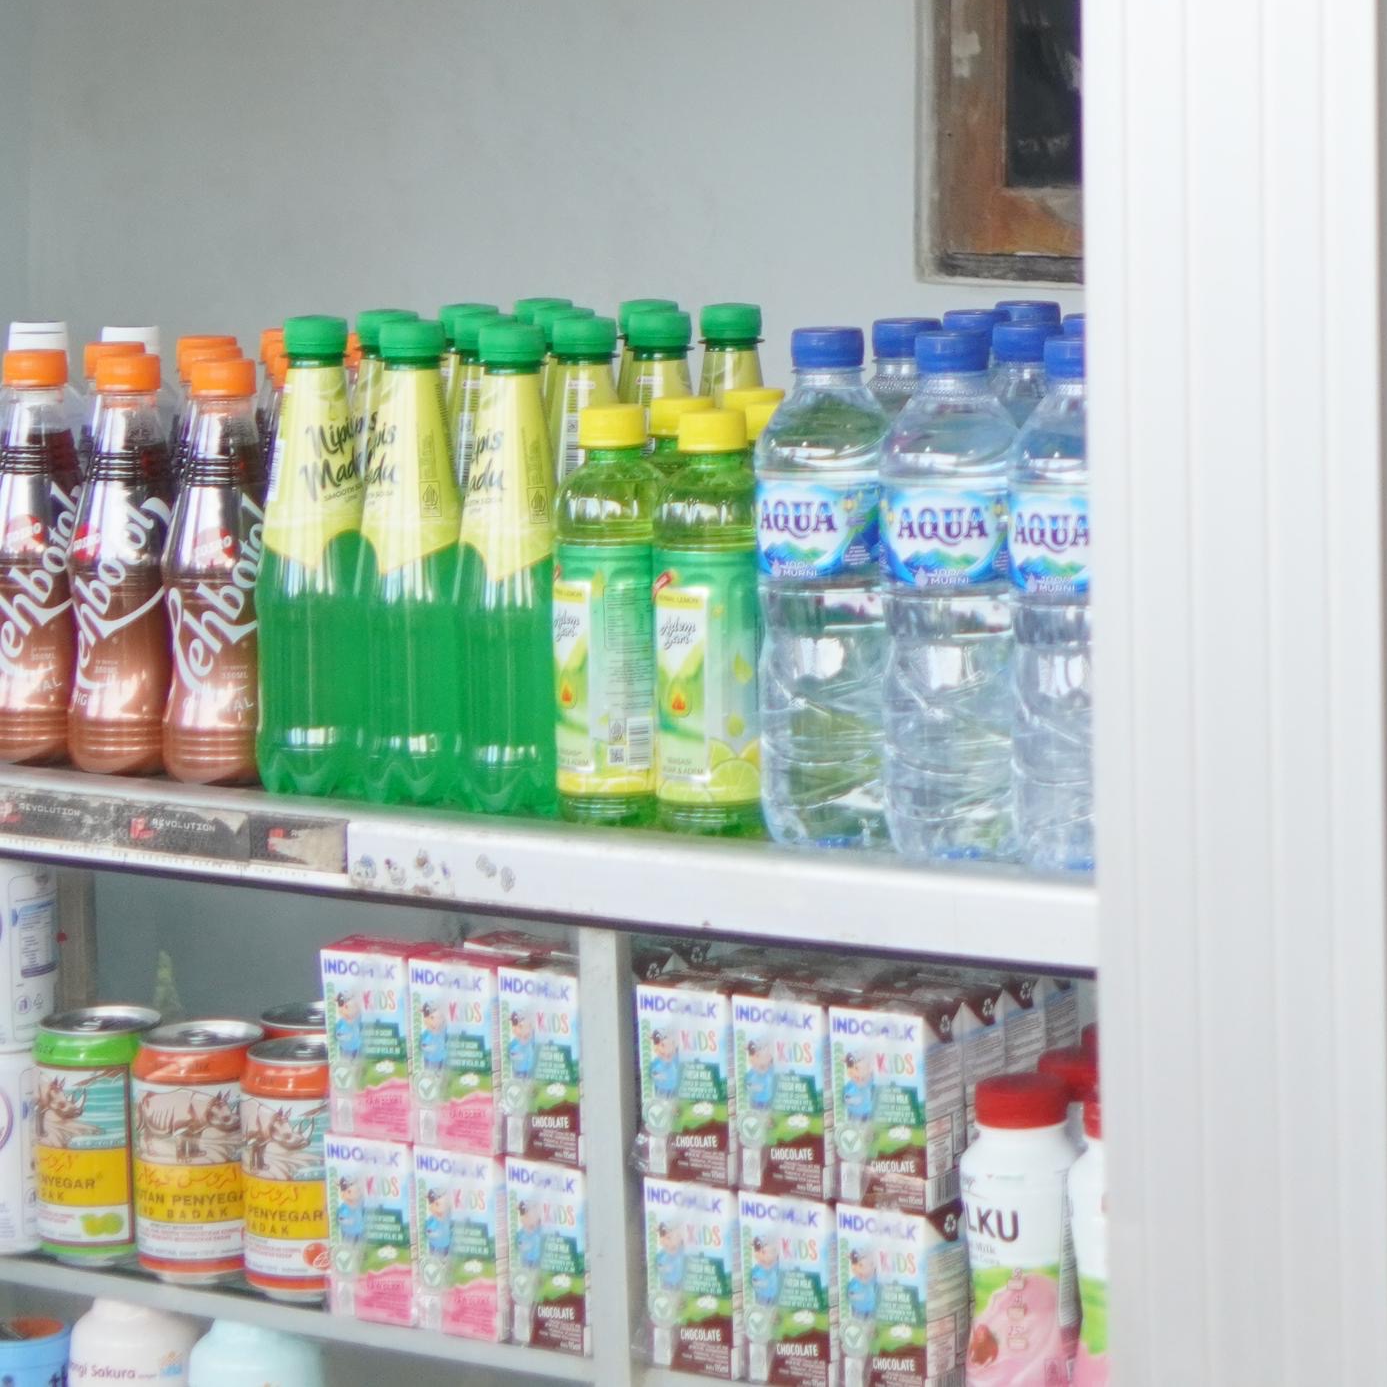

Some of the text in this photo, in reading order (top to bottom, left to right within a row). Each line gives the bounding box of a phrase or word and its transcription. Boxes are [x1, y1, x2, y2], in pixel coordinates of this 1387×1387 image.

[761, 499, 838, 539] AQUA
[897, 507, 988, 546] AQUA
[1014, 512, 1089, 553] AQUA
[930, 577, 969, 585] MURNI
[1038, 584, 1075, 592] MURNI
[19, 802, 80, 817] REVOLUTION
[151, 817, 216, 832] REVOLUTION
[362, 989, 396, 1011] KDS
[449, 1001, 482, 1023] KDS
[536, 1011, 569, 1035] KDS
[532, 1116, 569, 1128] CHOCOLATE
[676, 1135, 718, 1148] CHOCOLATE
[770, 1147, 813, 1161] CHOCOLATE
[871, 1160, 915, 1174] CHOCOLATE
[366, 1175, 400, 1198] KDS
[454, 1188, 486, 1210] KDS
[537, 1305, 575, 1319] CHOCOLATE
[680, 1327, 721, 1342] CHOCOLATE
[776, 1342, 819, 1357] CHOCOLATE
[872, 1357, 916, 1371] CHOCOLATE
[91, 1365, 136, 1380] Sakura
